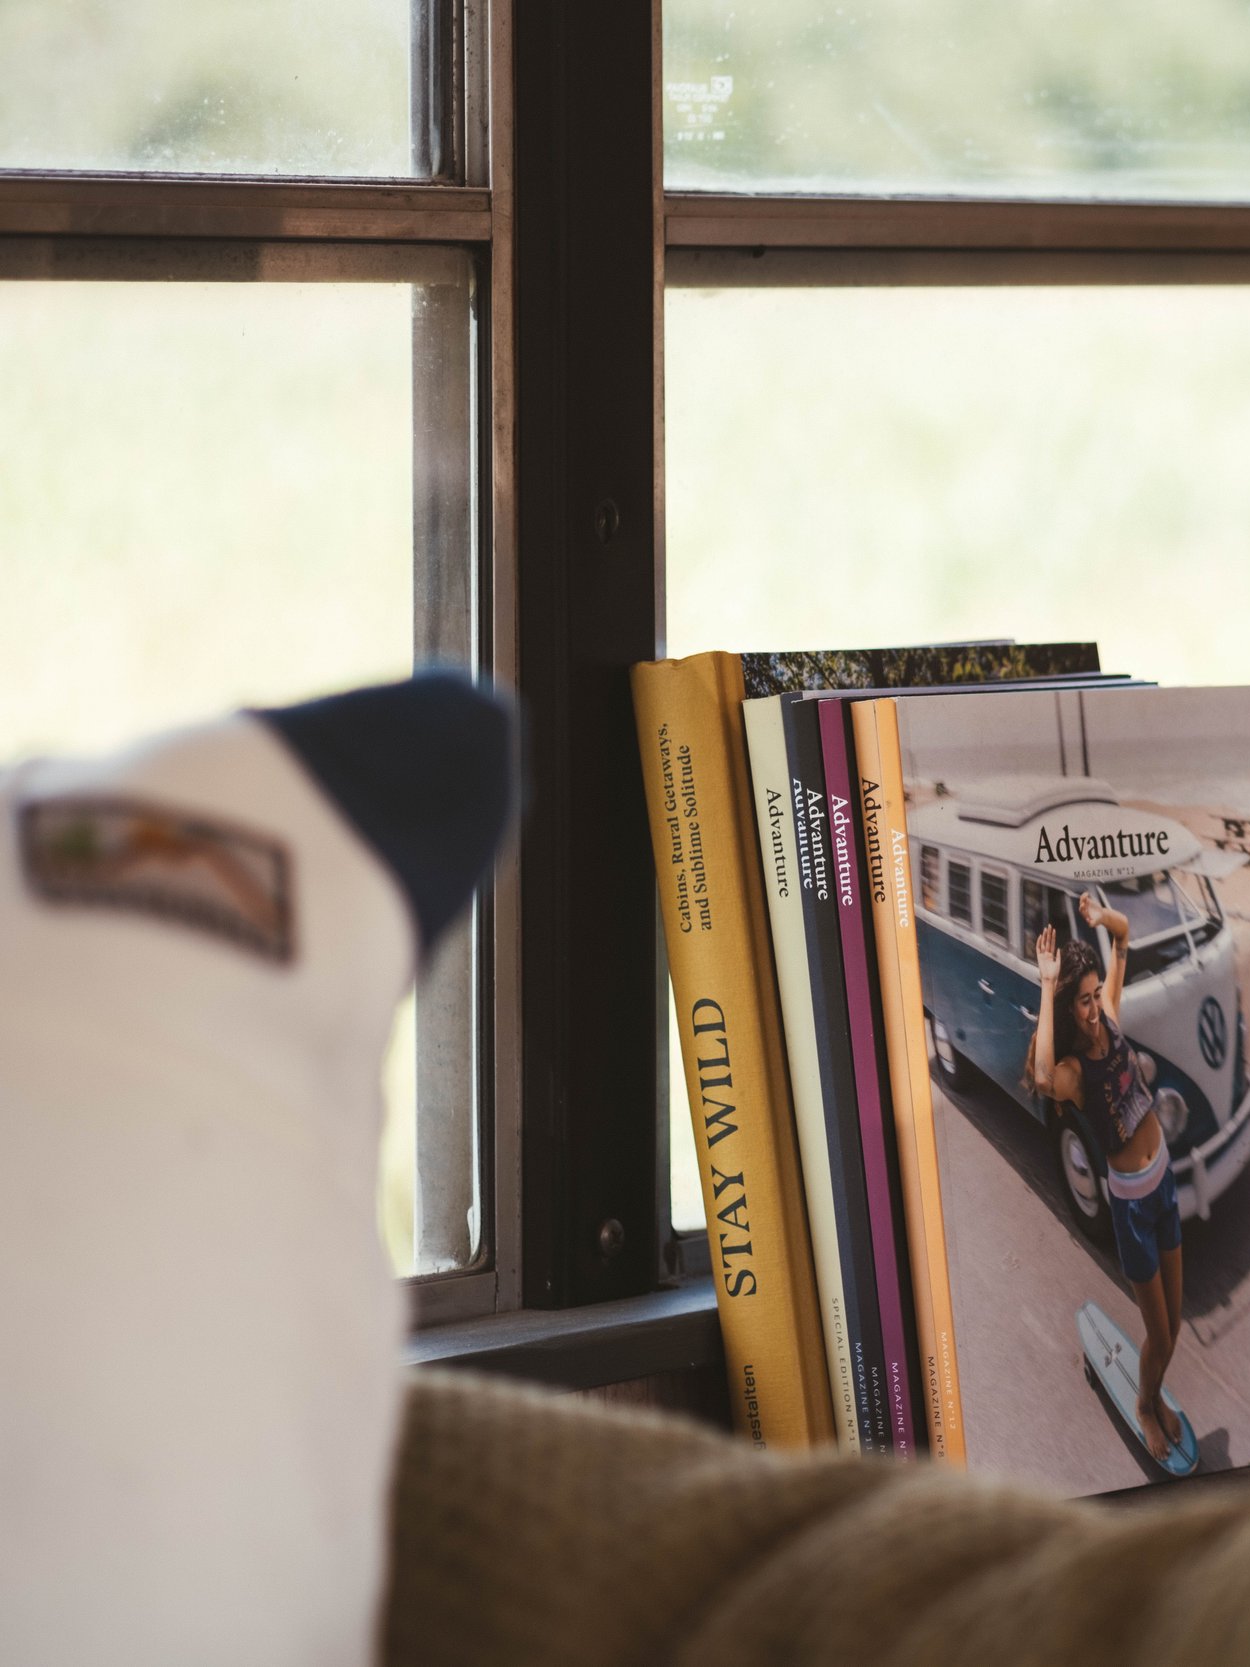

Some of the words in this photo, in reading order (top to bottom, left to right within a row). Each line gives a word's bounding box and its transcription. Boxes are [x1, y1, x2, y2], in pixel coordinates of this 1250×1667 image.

[658, 723, 677, 812] Getaways,
[678, 744, 698, 818] Solitude
[667, 816, 685, 865] Rural
[686, 822, 706, 893] Sublime
[766, 788, 790, 899] Advanture
[806, 788, 829, 901] Advanture
[831, 794, 853, 907] Advanture
[862, 777, 886, 904] Advanture
[1034, 824, 1170, 864] Advanture
[1073, 868, 1114, 879] MAGAZINE
[679, 869, 693, 933] Cabins,
[695, 898, 712, 931] and
[891, 829, 909, 928] Advanture
[691, 997, 739, 1148] WILD
[711, 1166, 757, 1298] STAY
[831, 1298, 844, 1351] SPECIAL
[839, 1358, 852, 1412] EDITION
[855, 1342, 869, 1413] MAGAZINE
[940, 1331, 952, 1395] MAGAZINE
[871, 1366, 885, 1437] MAGAZINE
[891, 1362, 905, 1433] MAGAZINE
[928, 1356, 942, 1428] MAGAZINE
